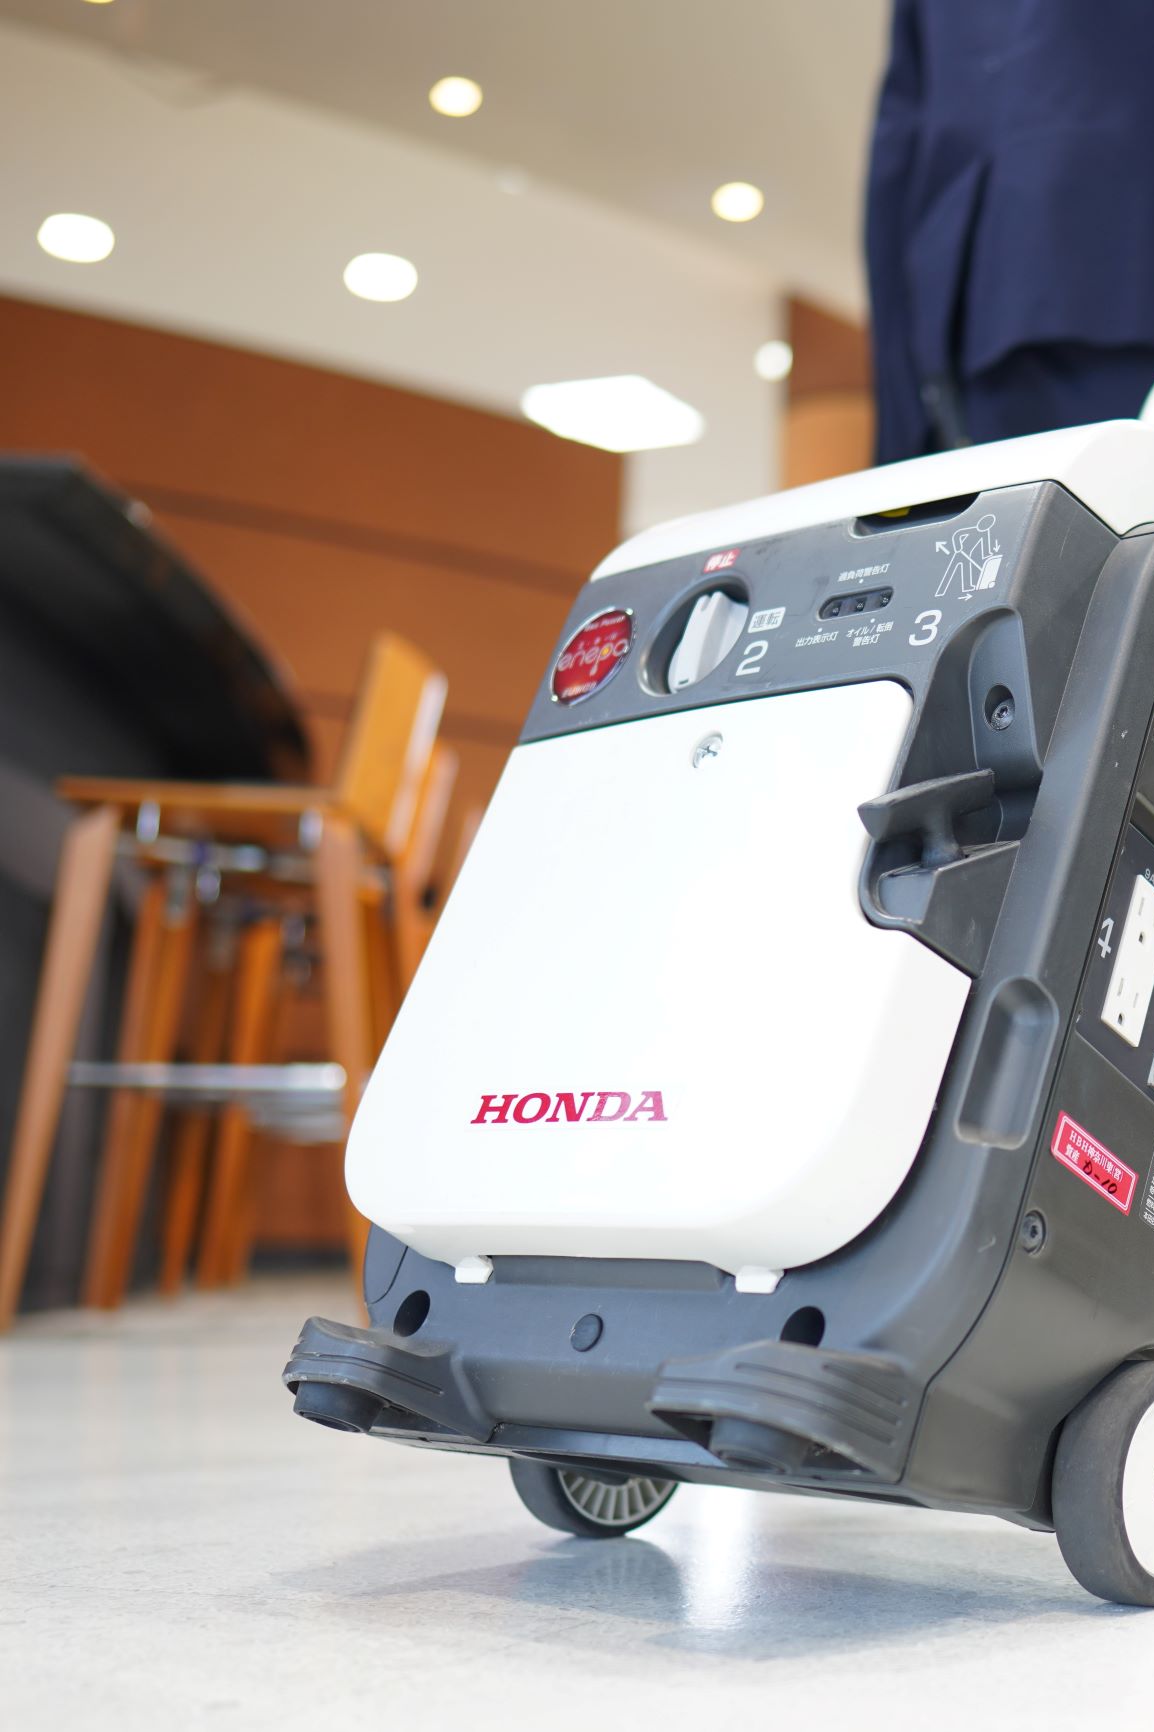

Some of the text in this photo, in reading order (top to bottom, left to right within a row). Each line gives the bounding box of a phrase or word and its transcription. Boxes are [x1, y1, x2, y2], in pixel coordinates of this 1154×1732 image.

[752, 612, 781, 629] 運転
[908, 609, 943, 646] 3
[795, 631, 838, 647] 出力表示灯
[852, 633, 881, 647] 警告灯
[557, 639, 629, 676] enepo
[735, 640, 768, 676] 2
[1097, 917, 1115, 958] 4
[470, 1090, 668, 1124] HONDA
